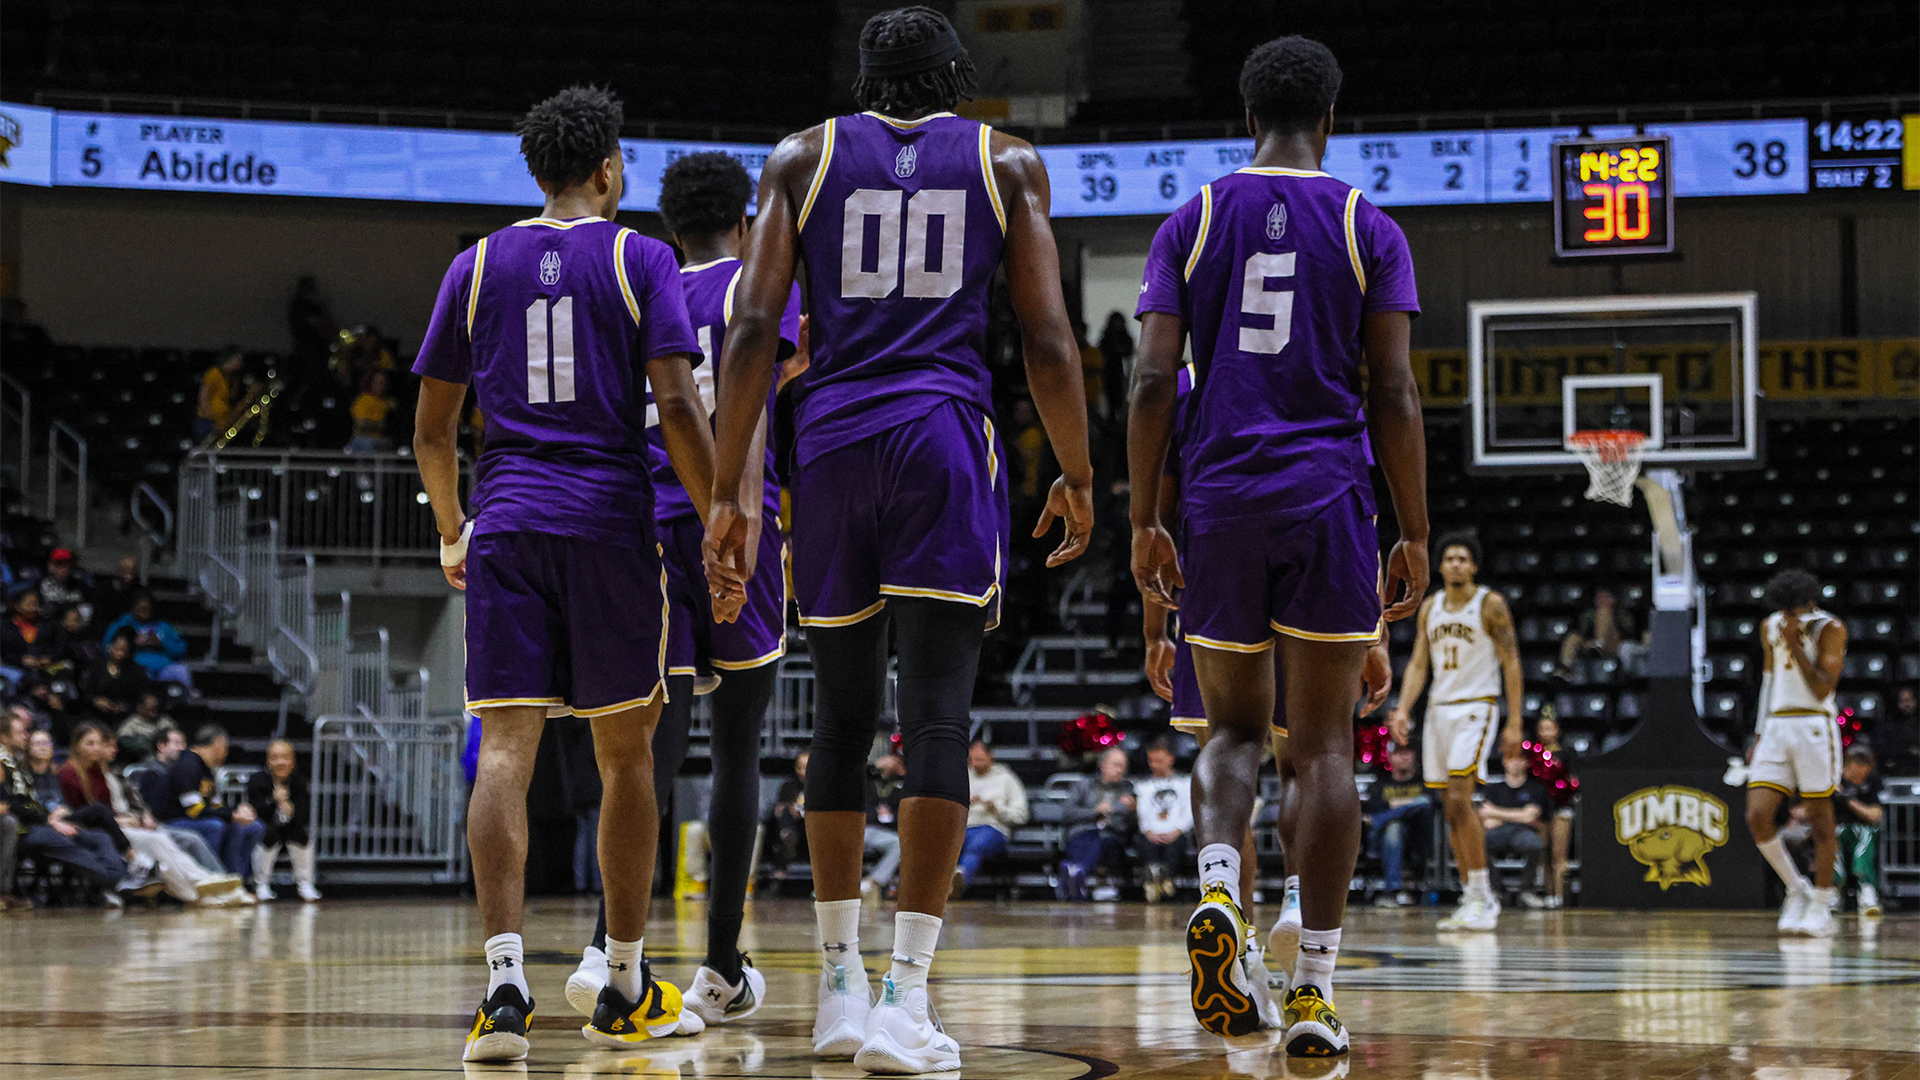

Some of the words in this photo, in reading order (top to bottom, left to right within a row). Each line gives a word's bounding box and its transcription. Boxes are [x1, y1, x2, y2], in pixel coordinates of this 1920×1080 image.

[139, 124, 224, 144] PLAYER
[1360, 141, 1399, 159] STL
[1431, 138, 1473, 156] BLK
[1517, 137, 1529, 161] 1
[1814, 120, 1903, 151] 14:22
[81, 147, 102, 178] 5
[139, 148, 277, 185] Abidde
[1145, 149, 1185, 167] AST
[1580, 147, 1659, 182] 14:22
[1735, 141, 1786, 178] 38
[1081, 173, 1117, 201] 39
[1159, 173, 1178, 200] 6
[1372, 163, 1390, 192] 2
[1444, 162, 1463, 190] 2
[1514, 167, 1530, 192] 2
[1873, 165, 1892, 189] 2
[1583, 182, 1650, 241] 30
[841, 188, 966, 298] 00
[1238, 251, 1297, 354] 5
[526, 296, 575, 404] 11
[1431, 623, 1474, 645] UMBC
[1444, 645, 1458, 671] 11
[1620, 793, 1724, 841] UMBC
